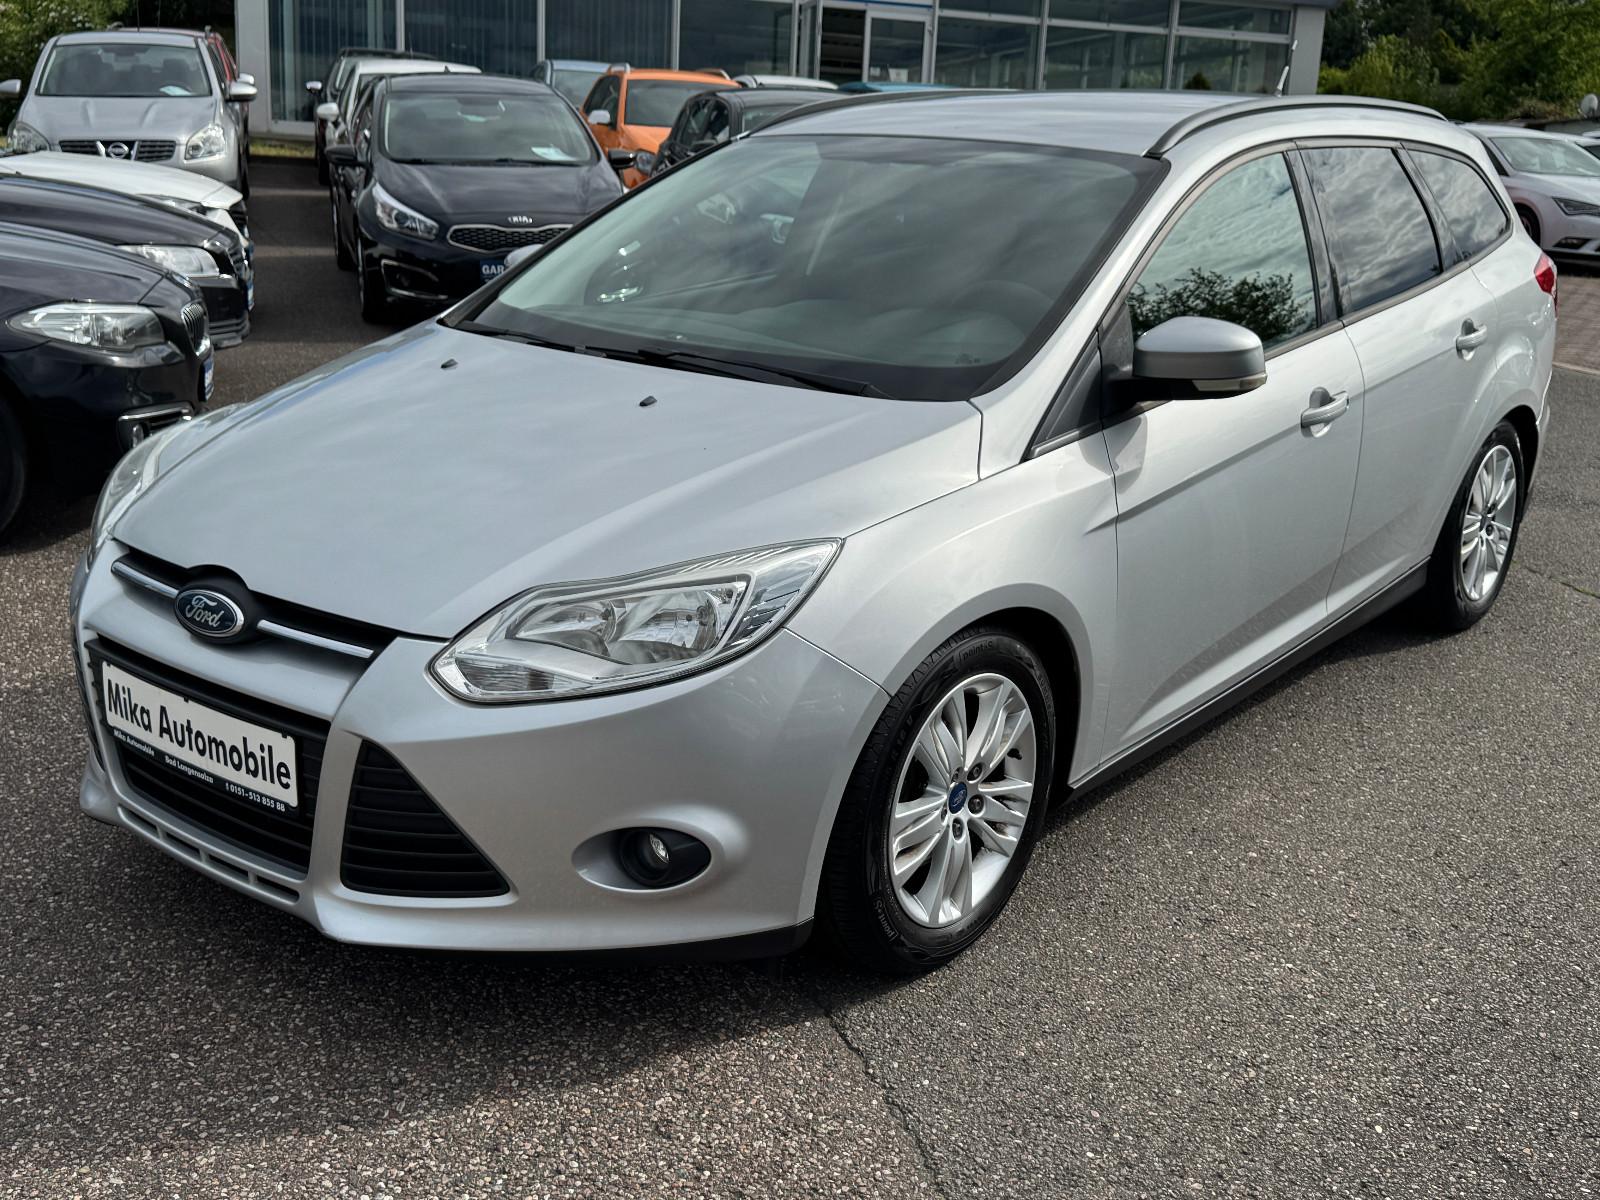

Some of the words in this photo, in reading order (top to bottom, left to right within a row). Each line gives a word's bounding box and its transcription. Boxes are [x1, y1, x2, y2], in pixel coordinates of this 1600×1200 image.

[510, 215, 531, 224] KIA
[185, 595, 225, 628] Ford
[107, 679, 152, 733] Mika
[159, 705, 292, 790] Automobile
[126, 735, 155, 757] Automobile
[164, 754, 177, 767] Bad
[230, 784, 261, 803] 0151-513
[261, 795, 275, 808] 855
[275, 801, 286, 812] 88
